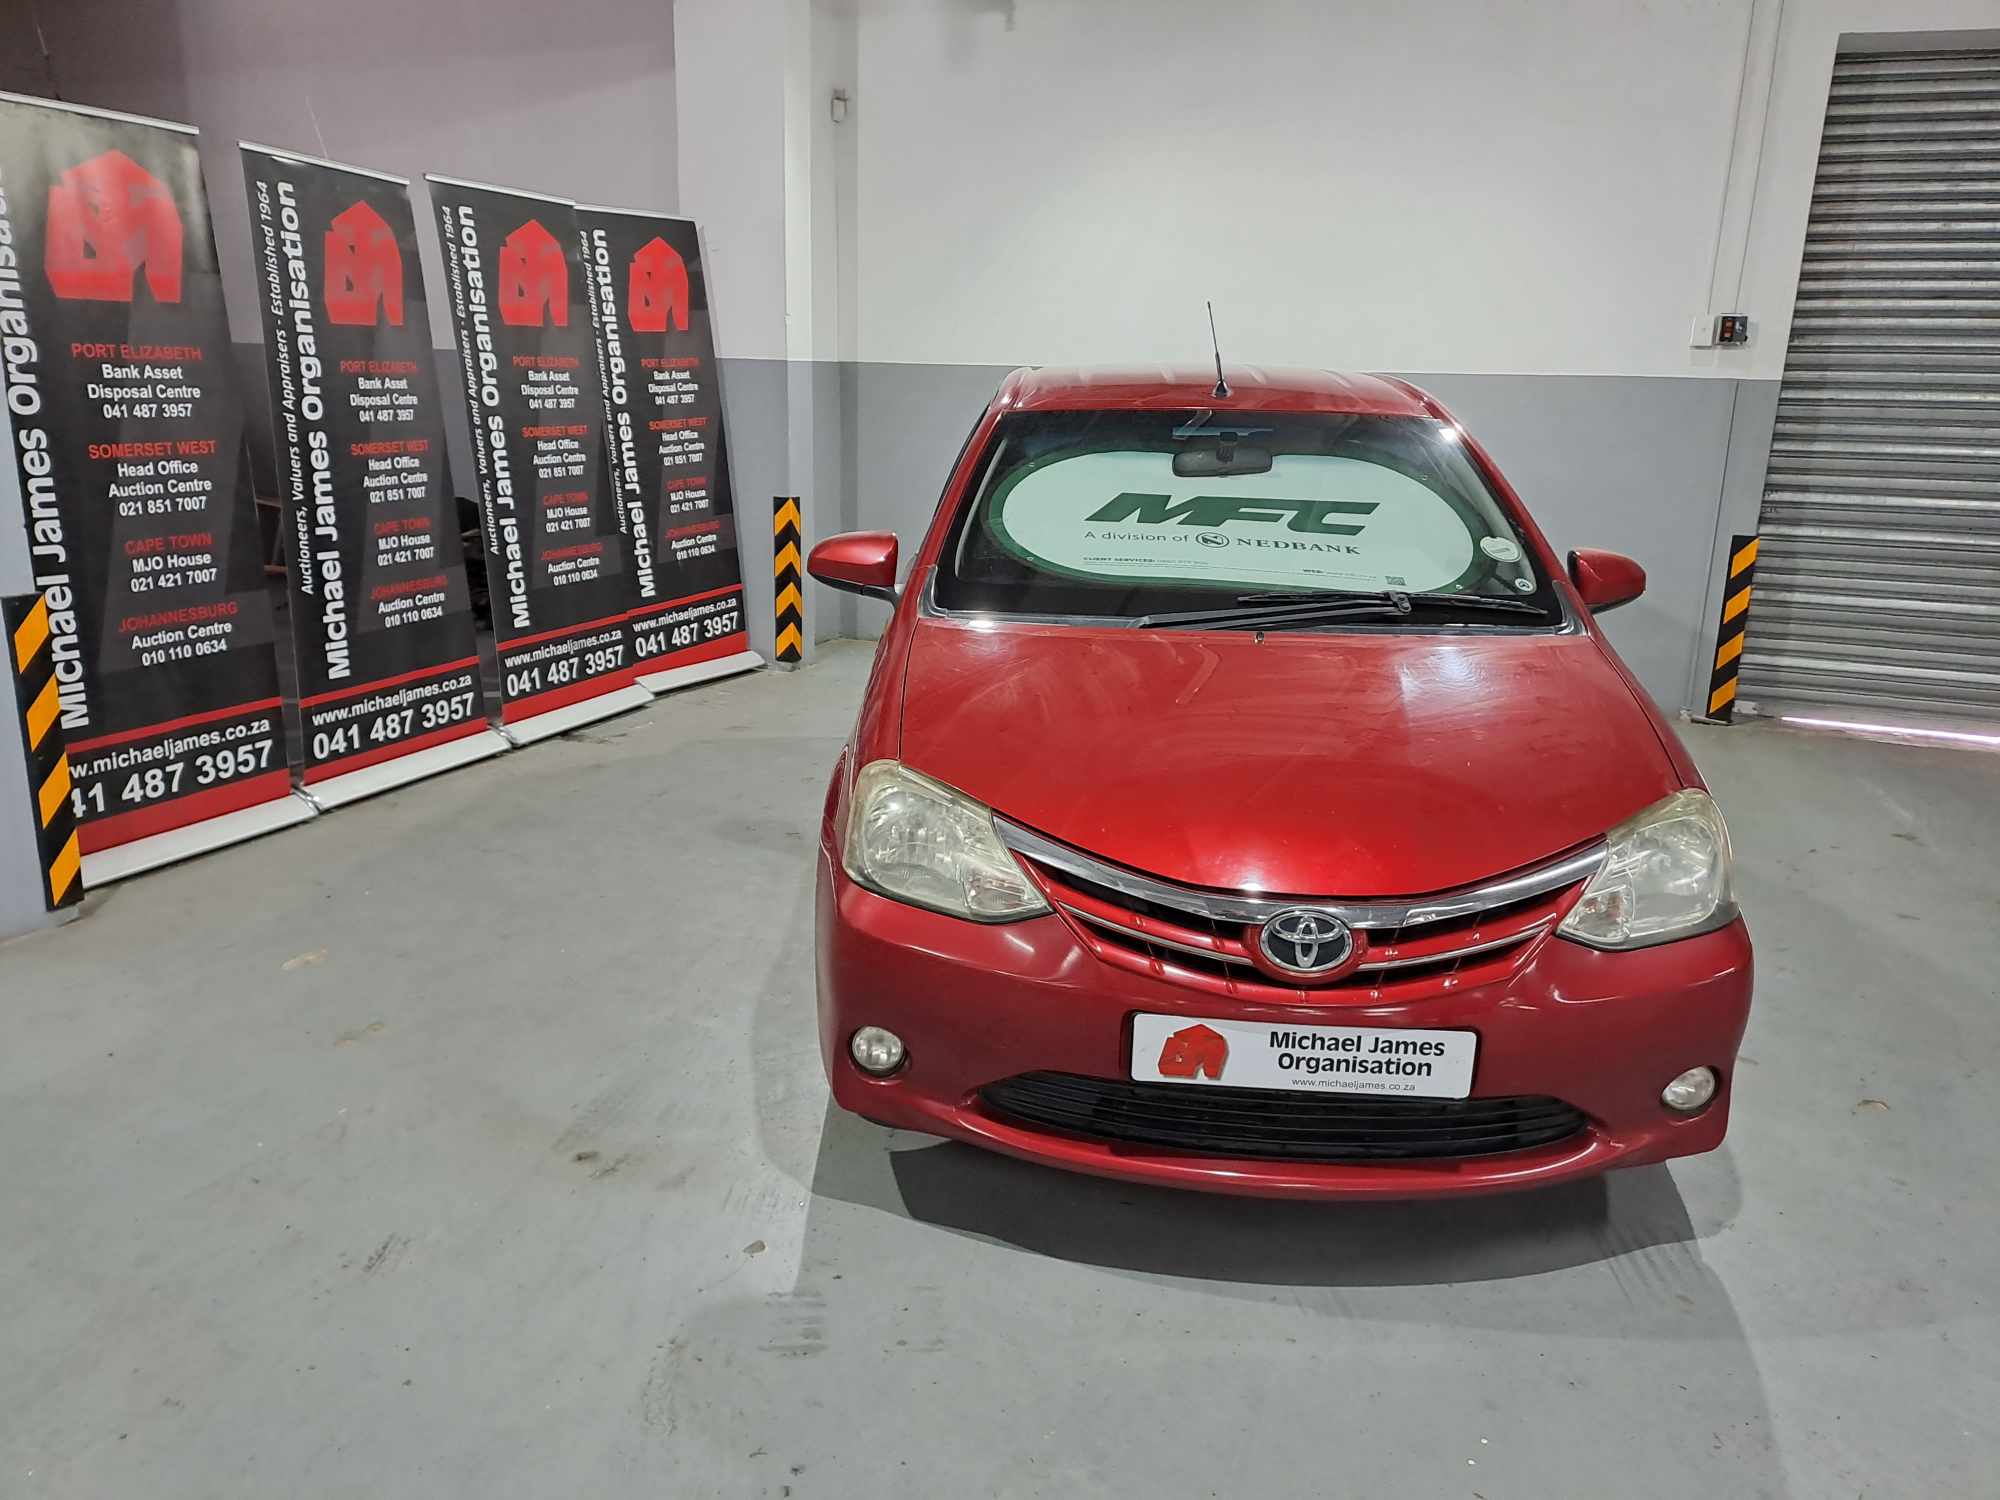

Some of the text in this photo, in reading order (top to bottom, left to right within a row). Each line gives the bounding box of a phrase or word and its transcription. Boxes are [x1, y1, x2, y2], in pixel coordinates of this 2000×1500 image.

[450, 242, 466, 318] Established
[71, 343, 202, 360] PORT ELIZABETH
[461, 329, 477, 397] Appraisers
[102, 364, 183, 379] Bank Asset
[358, 378, 382, 390] Bank
[87, 384, 201, 401] Disposal Centre
[256, 181, 314, 595] Auctioneers, Valuers and Appraisers Established 1964
[350, 394, 391, 407] Disposal
[103, 403, 192, 419] 041 487 3957
[359, 410, 375, 422] 041
[377, 409, 393, 421] 487
[459, 206, 530, 628] Michael James Organisation
[471, 400, 481, 425] and
[593, 229, 656, 597] Michael James Organisation
[278, 181, 350, 680] Michael James Organisation
[88, 440, 216, 459] SOMERSET WEST
[476, 428, 487, 474] Valuers
[117, 460, 198, 478] Head Office
[368, 457, 420, 471] Head Office
[109, 478, 212, 498] Auction Centre
[363, 474, 398, 488] Auction
[19, 428, 66, 563] James
[119, 496, 207, 517] 021 851 7007
[370, 491, 385, 503] 021
[483, 480, 500, 555] Auctioneers,
[1084, 492, 1380, 536] MFC
[124, 533, 212, 554] CAPE TOWN
[378, 534, 431, 551] MJO House
[1084, 531, 1361, 554] A division of NEDBANK
[133, 553, 212, 573] MJO House
[378, 554, 392, 566] 021
[394, 551, 411, 563] 421
[131, 569, 217, 593] 021 421 7007
[378, 592, 445, 614] Auction Centre
[633, 597, 737, 632] www.michaeljames.co.za
[118, 601, 239, 632] JOHANNESBURG
[385, 615, 400, 628] 010
[402, 611, 418, 624] 110
[132, 621, 232, 650] Auction Centre
[635, 611, 738, 657] 041 487 3957
[36, 574, 89, 729] Michael
[142, 639, 228, 666] 010 110 0634
[505, 630, 622, 668] www.michaeljames.co.za
[507, 645, 624, 697] 041 487 3957
[312, 675, 472, 726] www.michaeljames.co.za
[313, 692, 475, 760] 041 487 3957
[122, 762, 184, 803] 487
[195, 739, 273, 784] 3957
[1269, 1031, 1446, 1057] Michael James
[1278, 1052, 1433, 1077] Organisation
[1292, 1078, 1416, 1092] www.michaeljames.co.za
